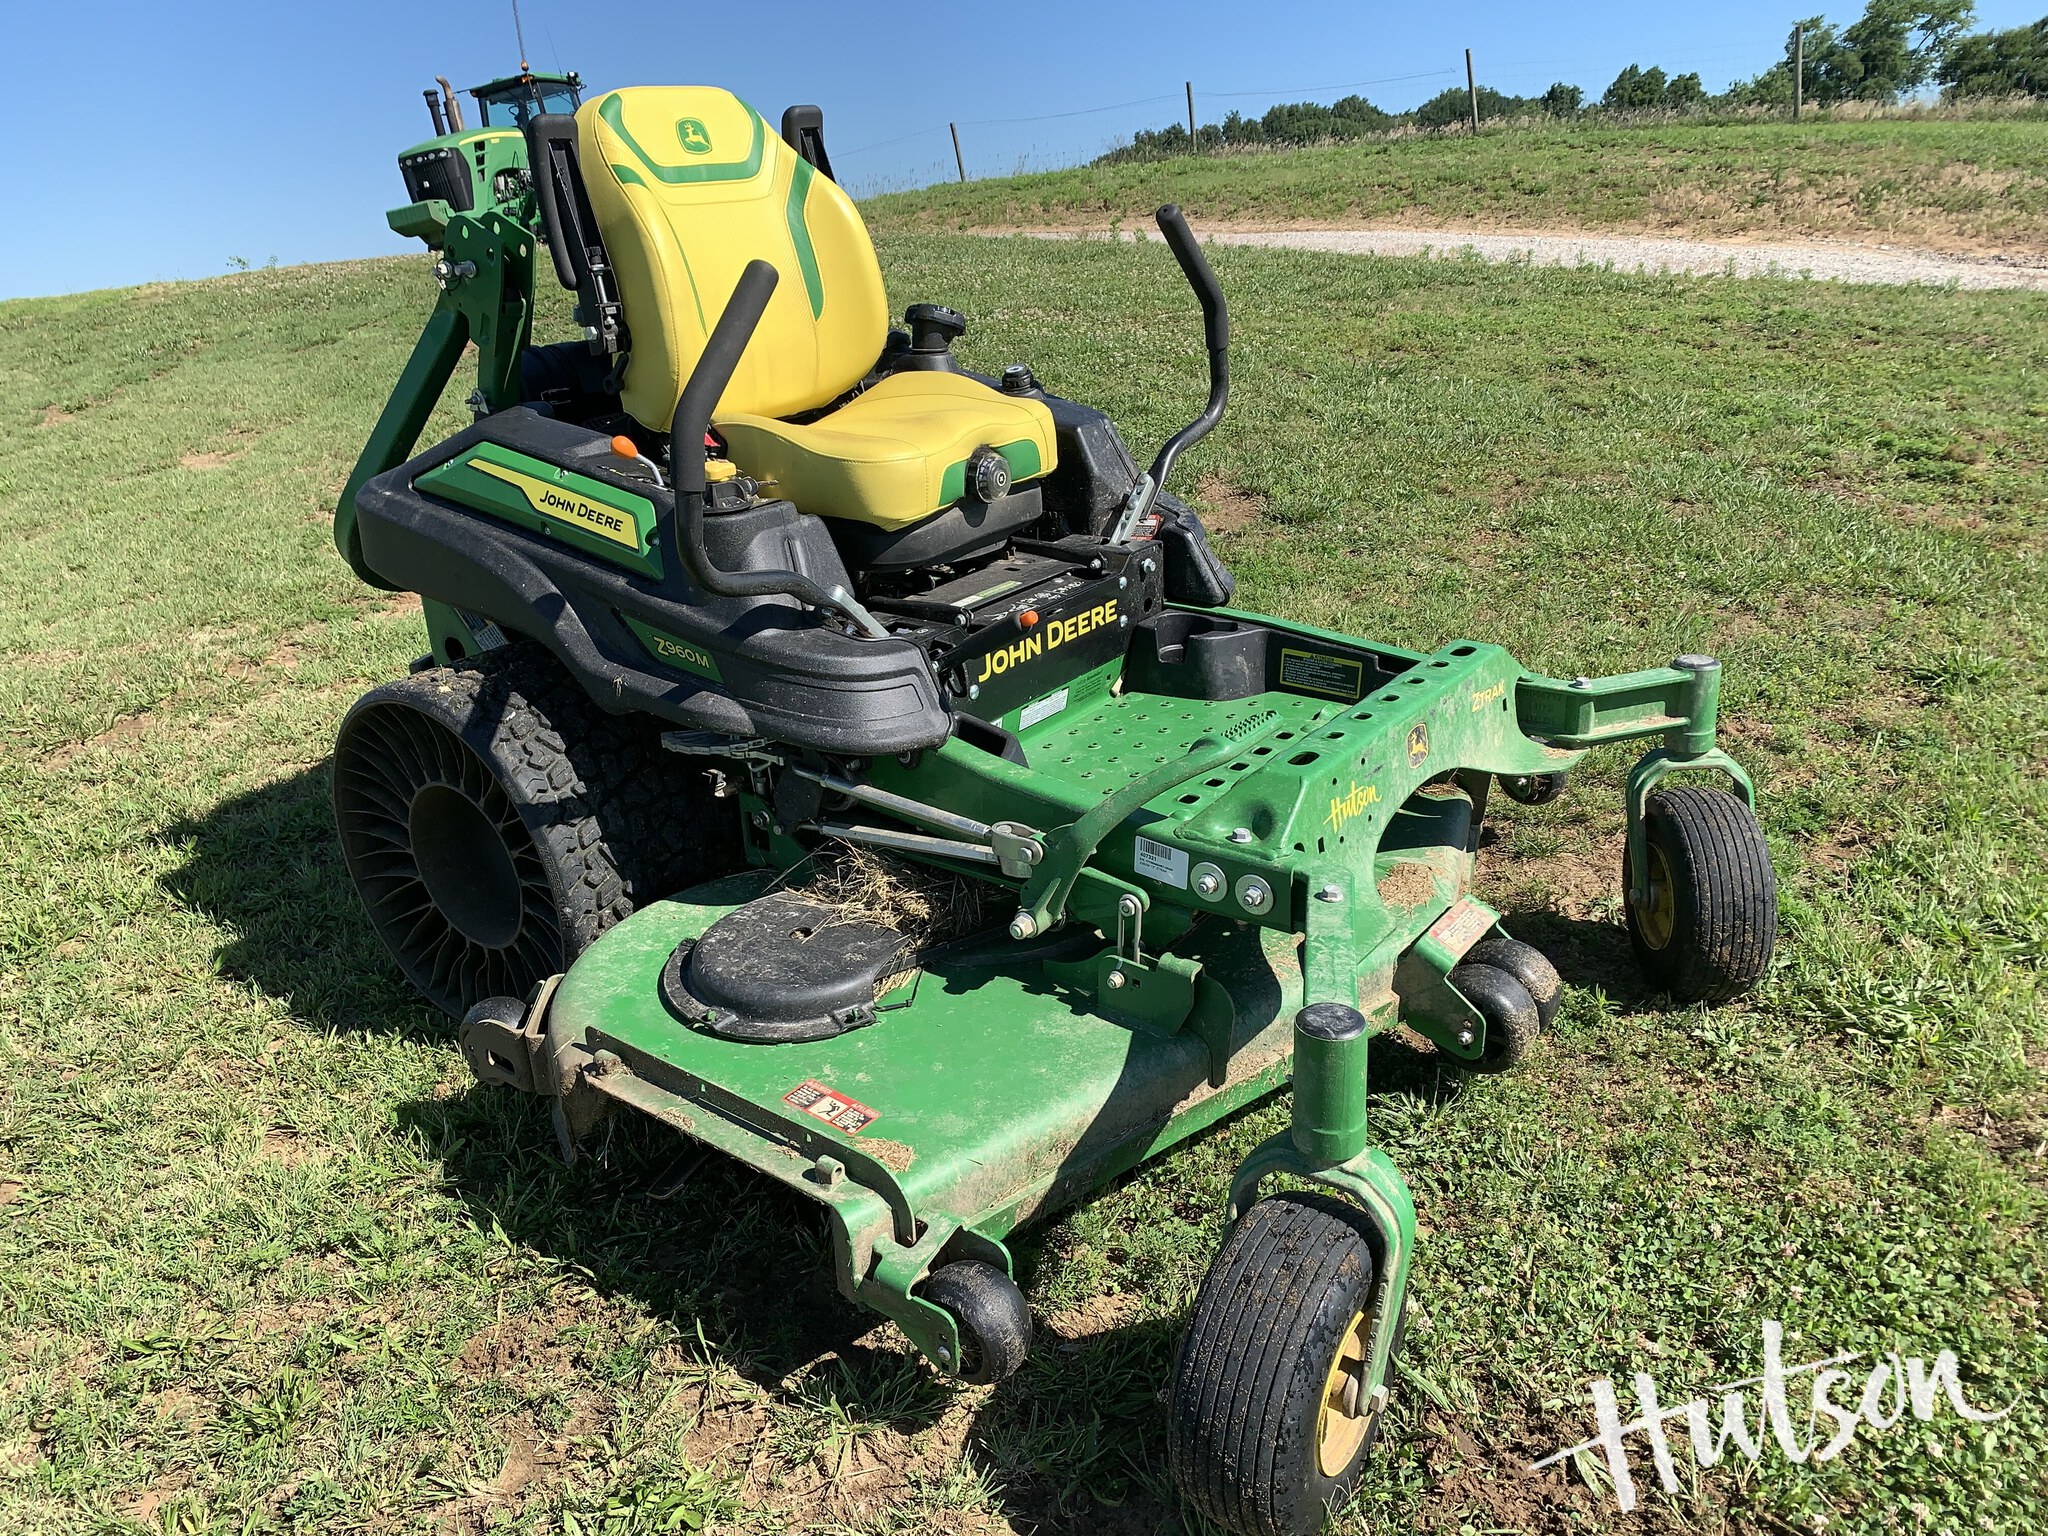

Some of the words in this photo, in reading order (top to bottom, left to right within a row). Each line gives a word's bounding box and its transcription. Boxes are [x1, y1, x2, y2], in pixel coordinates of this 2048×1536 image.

[540, 490, 575, 514] JOHN
[577, 502, 624, 533] DEERE
[653, 636, 710, 669] Z960M
[978, 632, 1042, 682] JOHN
[1047, 599, 1118, 650] DEERE
[1471, 679, 1505, 713] ZTRAK
[1323, 780, 1382, 834] Hutson
